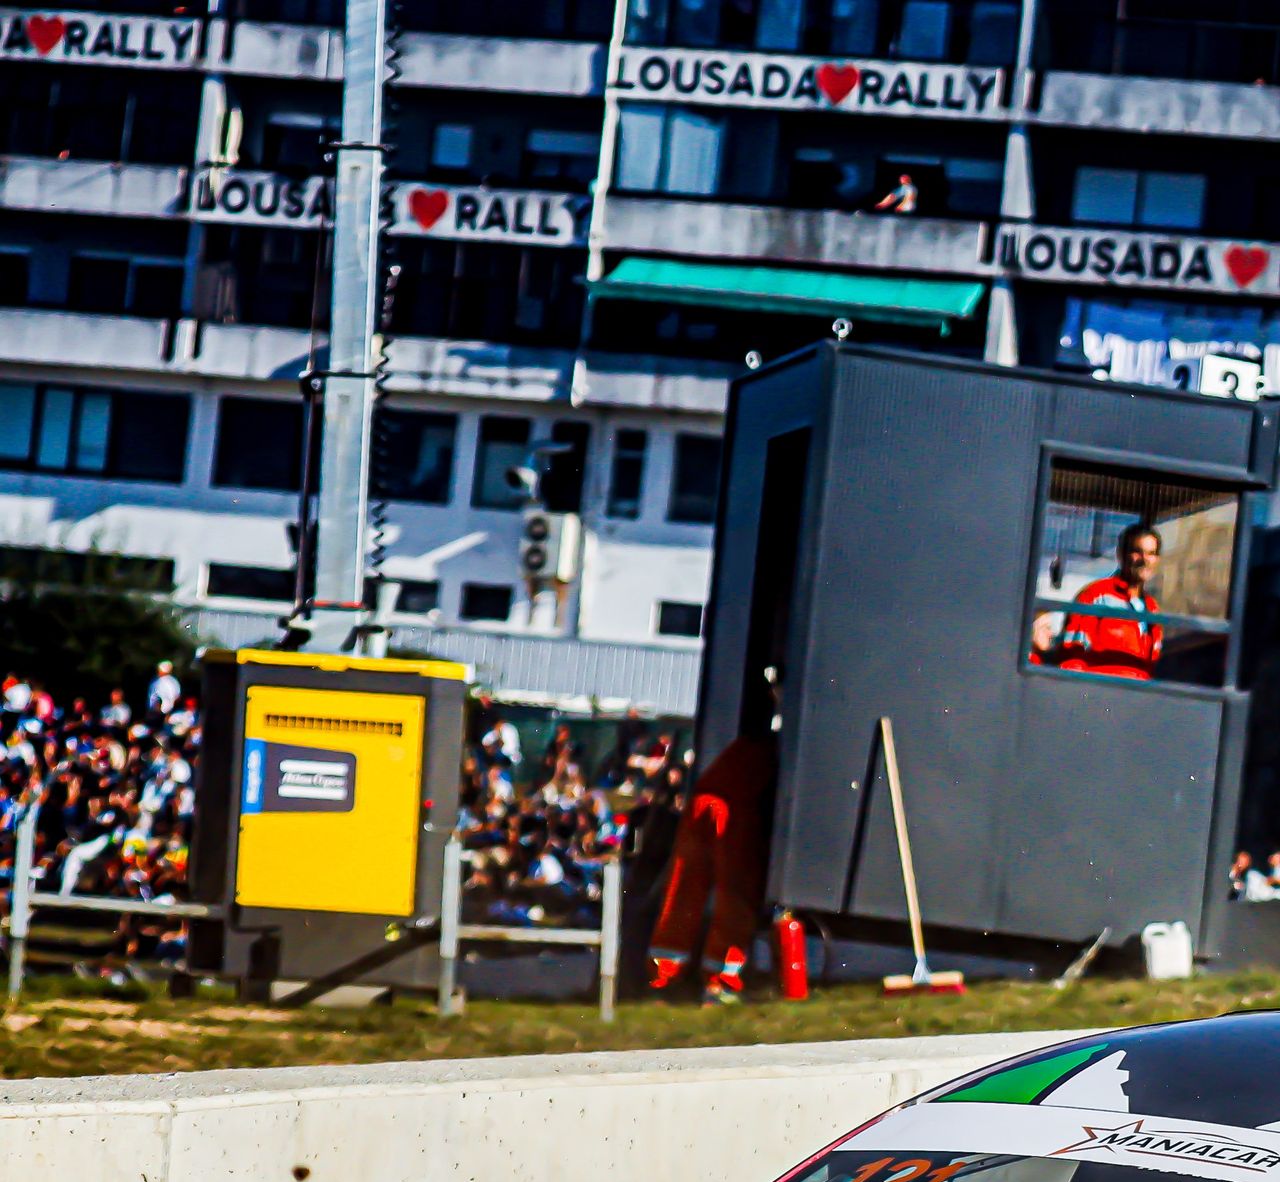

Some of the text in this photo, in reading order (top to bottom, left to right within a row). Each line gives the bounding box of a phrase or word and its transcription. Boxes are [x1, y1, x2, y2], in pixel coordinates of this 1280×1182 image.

[64, 20, 194, 61] RALLY
[610, 55, 996, 112] LOUSADA RALLY
[455, 192, 592, 244] RALLY
[1001, 232, 1213, 284] LOUSADA
